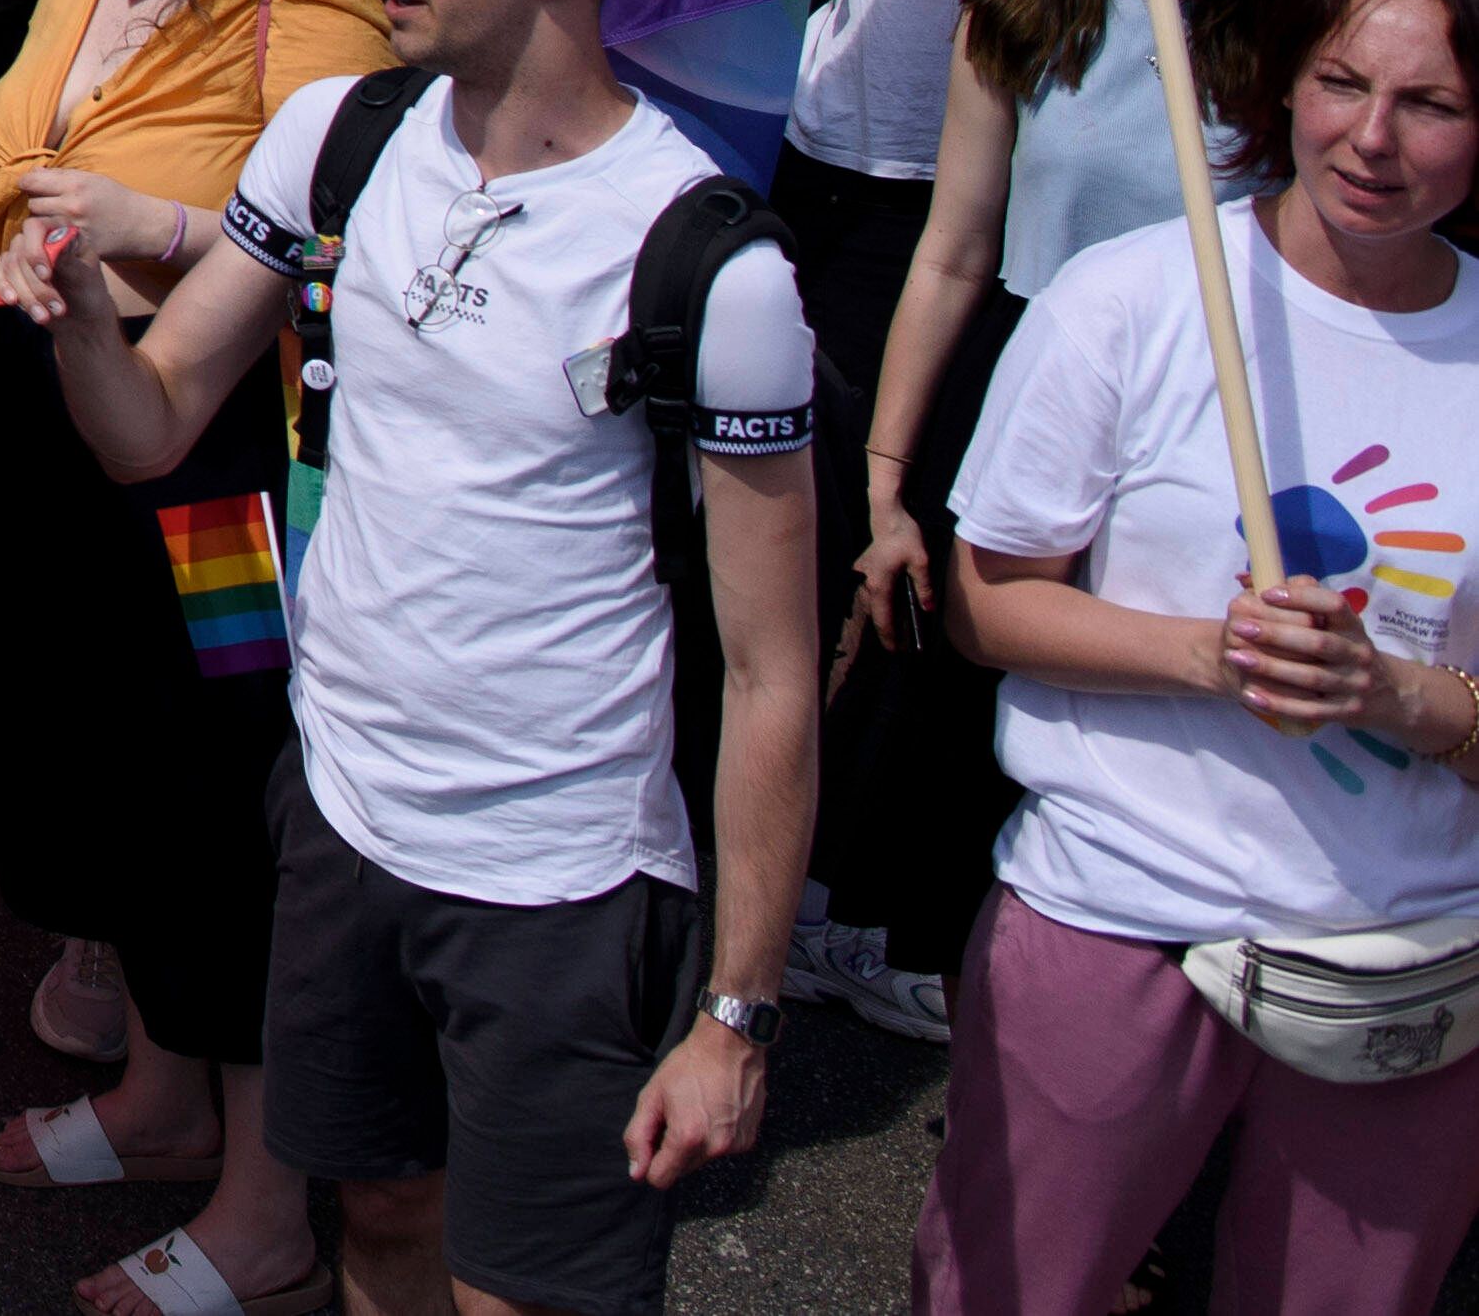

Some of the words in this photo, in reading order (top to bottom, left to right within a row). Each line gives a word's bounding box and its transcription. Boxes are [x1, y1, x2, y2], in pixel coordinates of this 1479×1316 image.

[227, 198, 271, 243] ACTS
[415, 267, 489, 308] FACTS
[714, 415, 796, 438] FACTS
